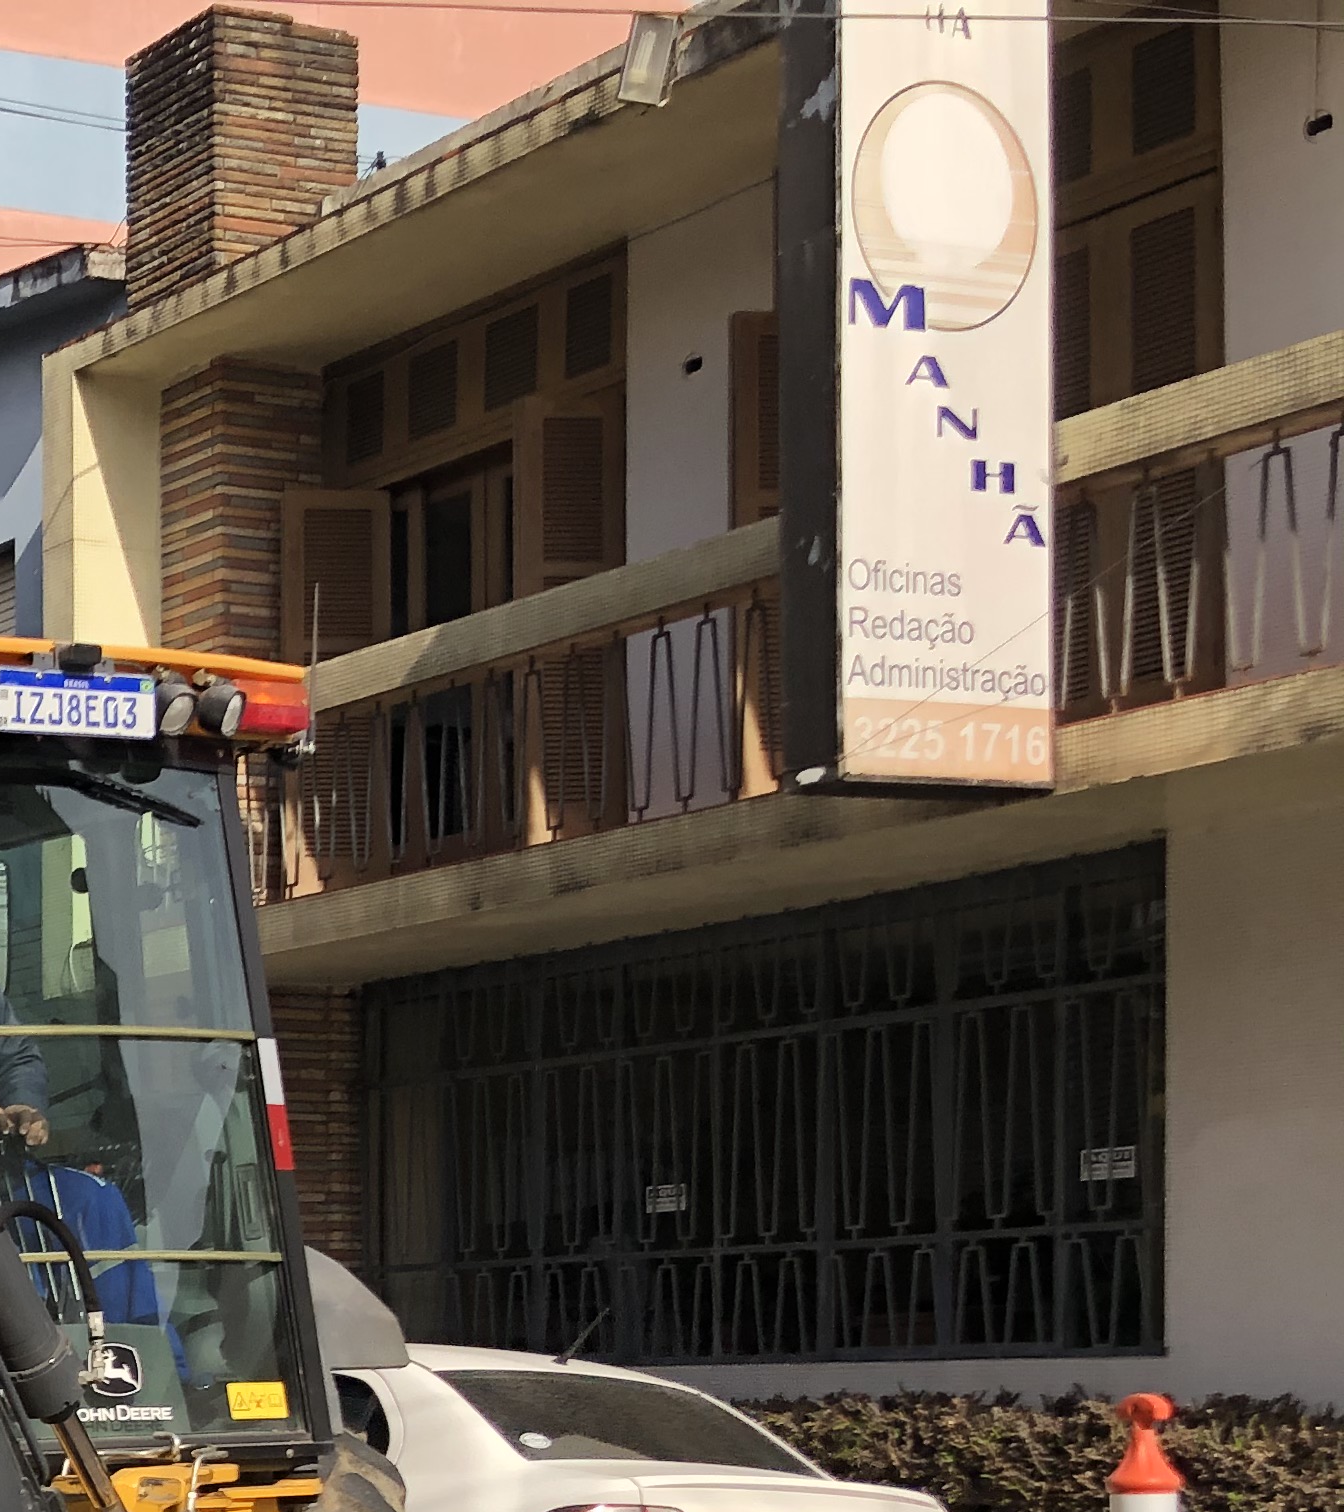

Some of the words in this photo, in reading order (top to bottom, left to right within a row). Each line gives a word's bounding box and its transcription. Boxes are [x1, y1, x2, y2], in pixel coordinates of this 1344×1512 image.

[848, 276, 1046, 548] MANHÃ
[847, 557, 963, 598] Oficinas
[848, 605, 976, 651] Redação
[847, 653, 1048, 703] Administração
[10, 690, 138, 730] IZJ8E03
[854, 715, 947, 762] 3225
[959, 720, 1047, 767] 1716
[76, 1406, 115, 1422] OHN
[115, 1404, 174, 1422] DEERE
